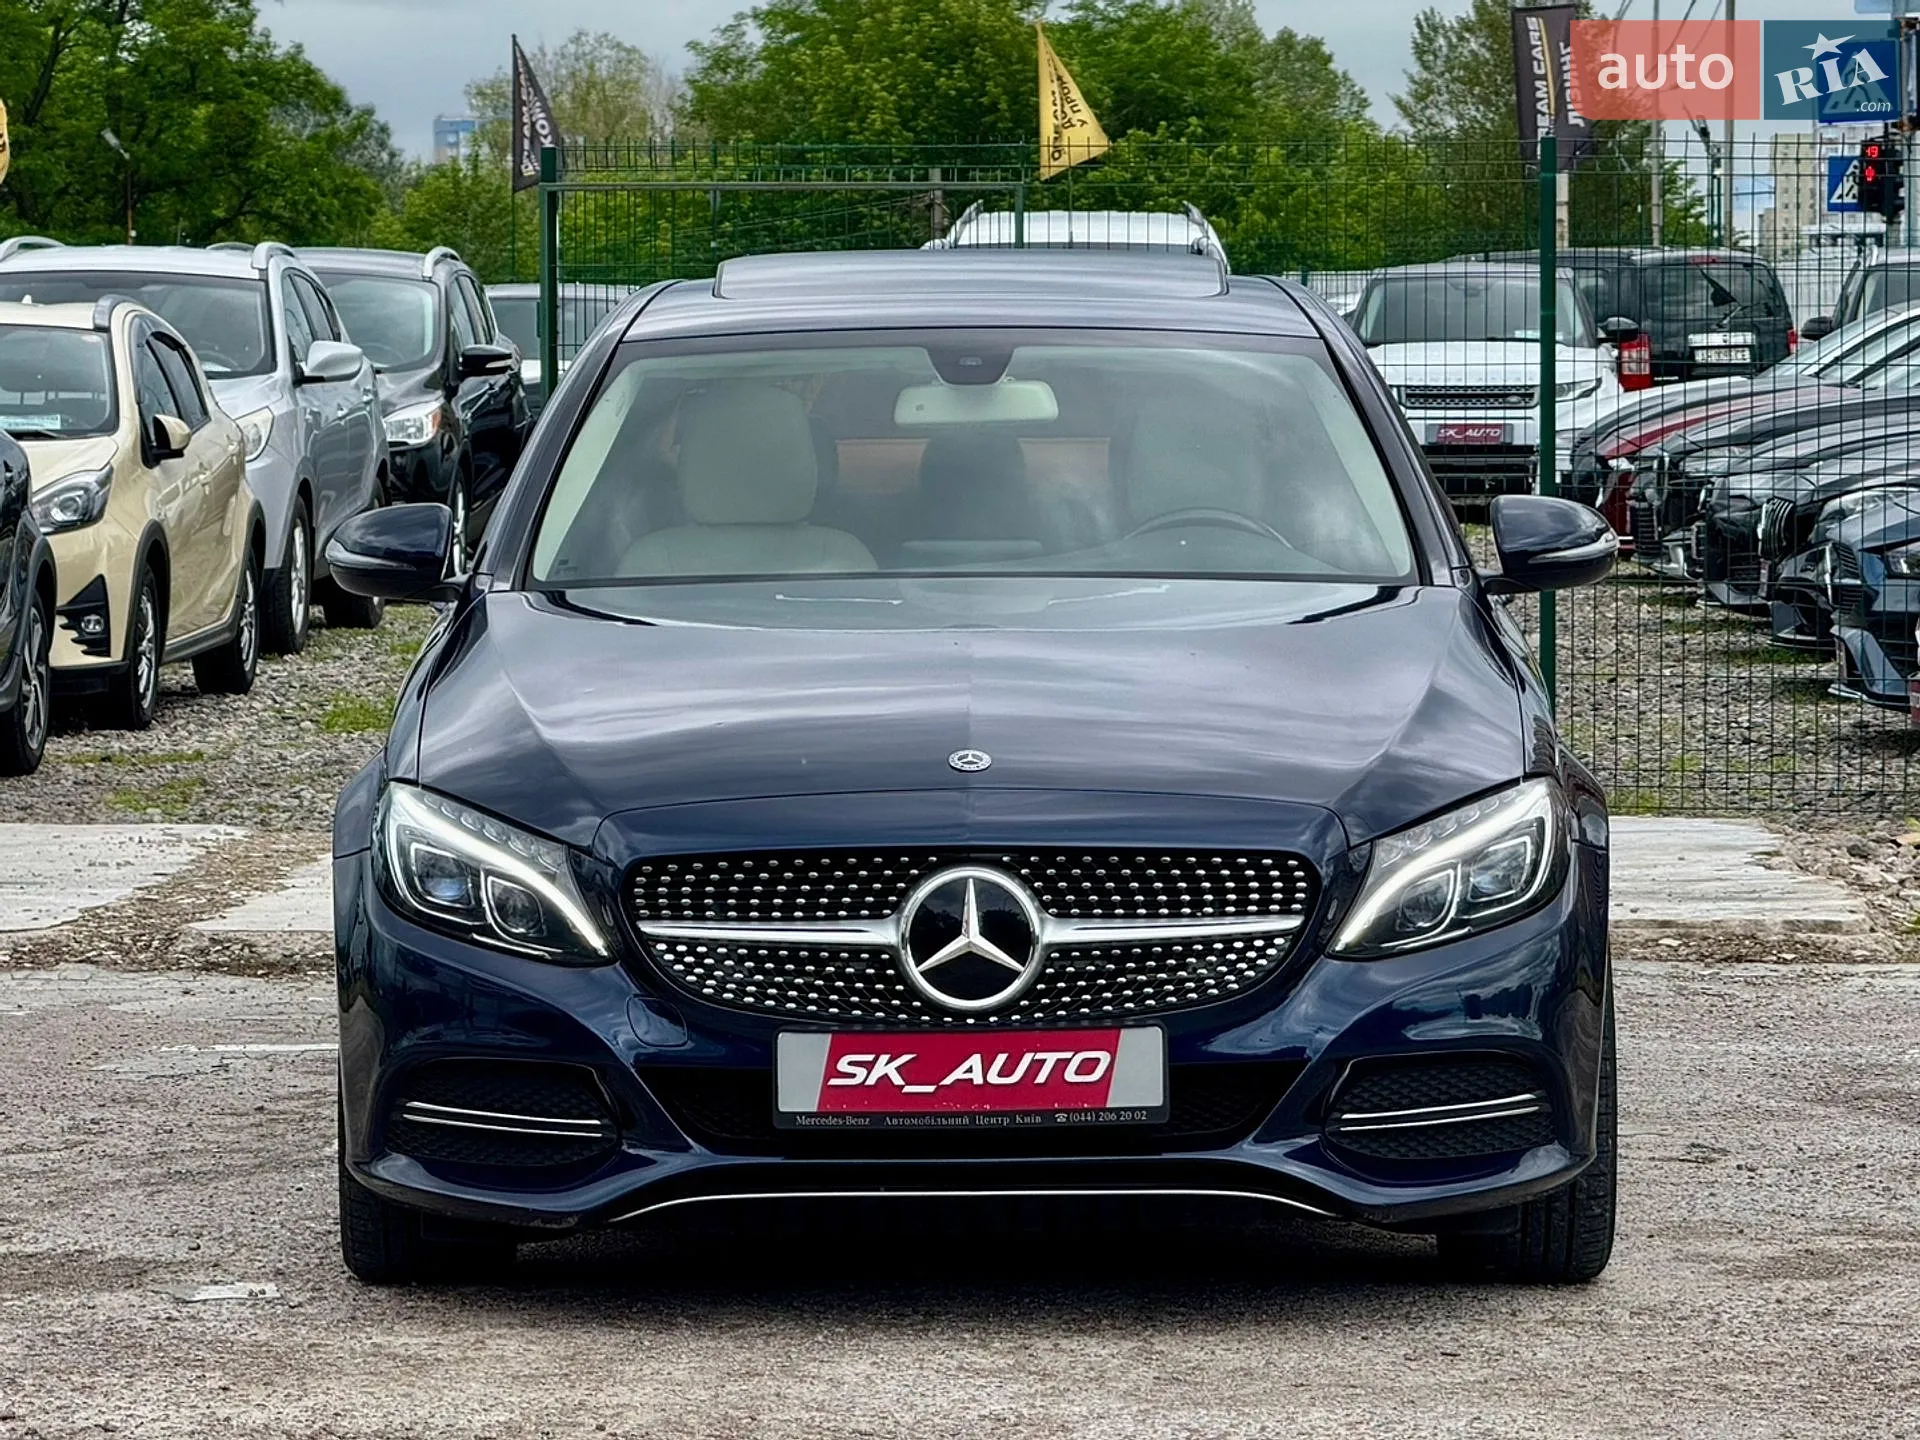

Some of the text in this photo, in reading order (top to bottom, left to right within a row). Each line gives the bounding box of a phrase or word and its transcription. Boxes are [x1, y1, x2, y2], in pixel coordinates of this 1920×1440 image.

[1526, 17, 1546, 75] CARS
[827, 1050, 1111, 1093] SK_AUTO
[796, 1110, 1147, 1127] Mercedes-Benz Автомобільний Центр Київ (044) 206 20 02
